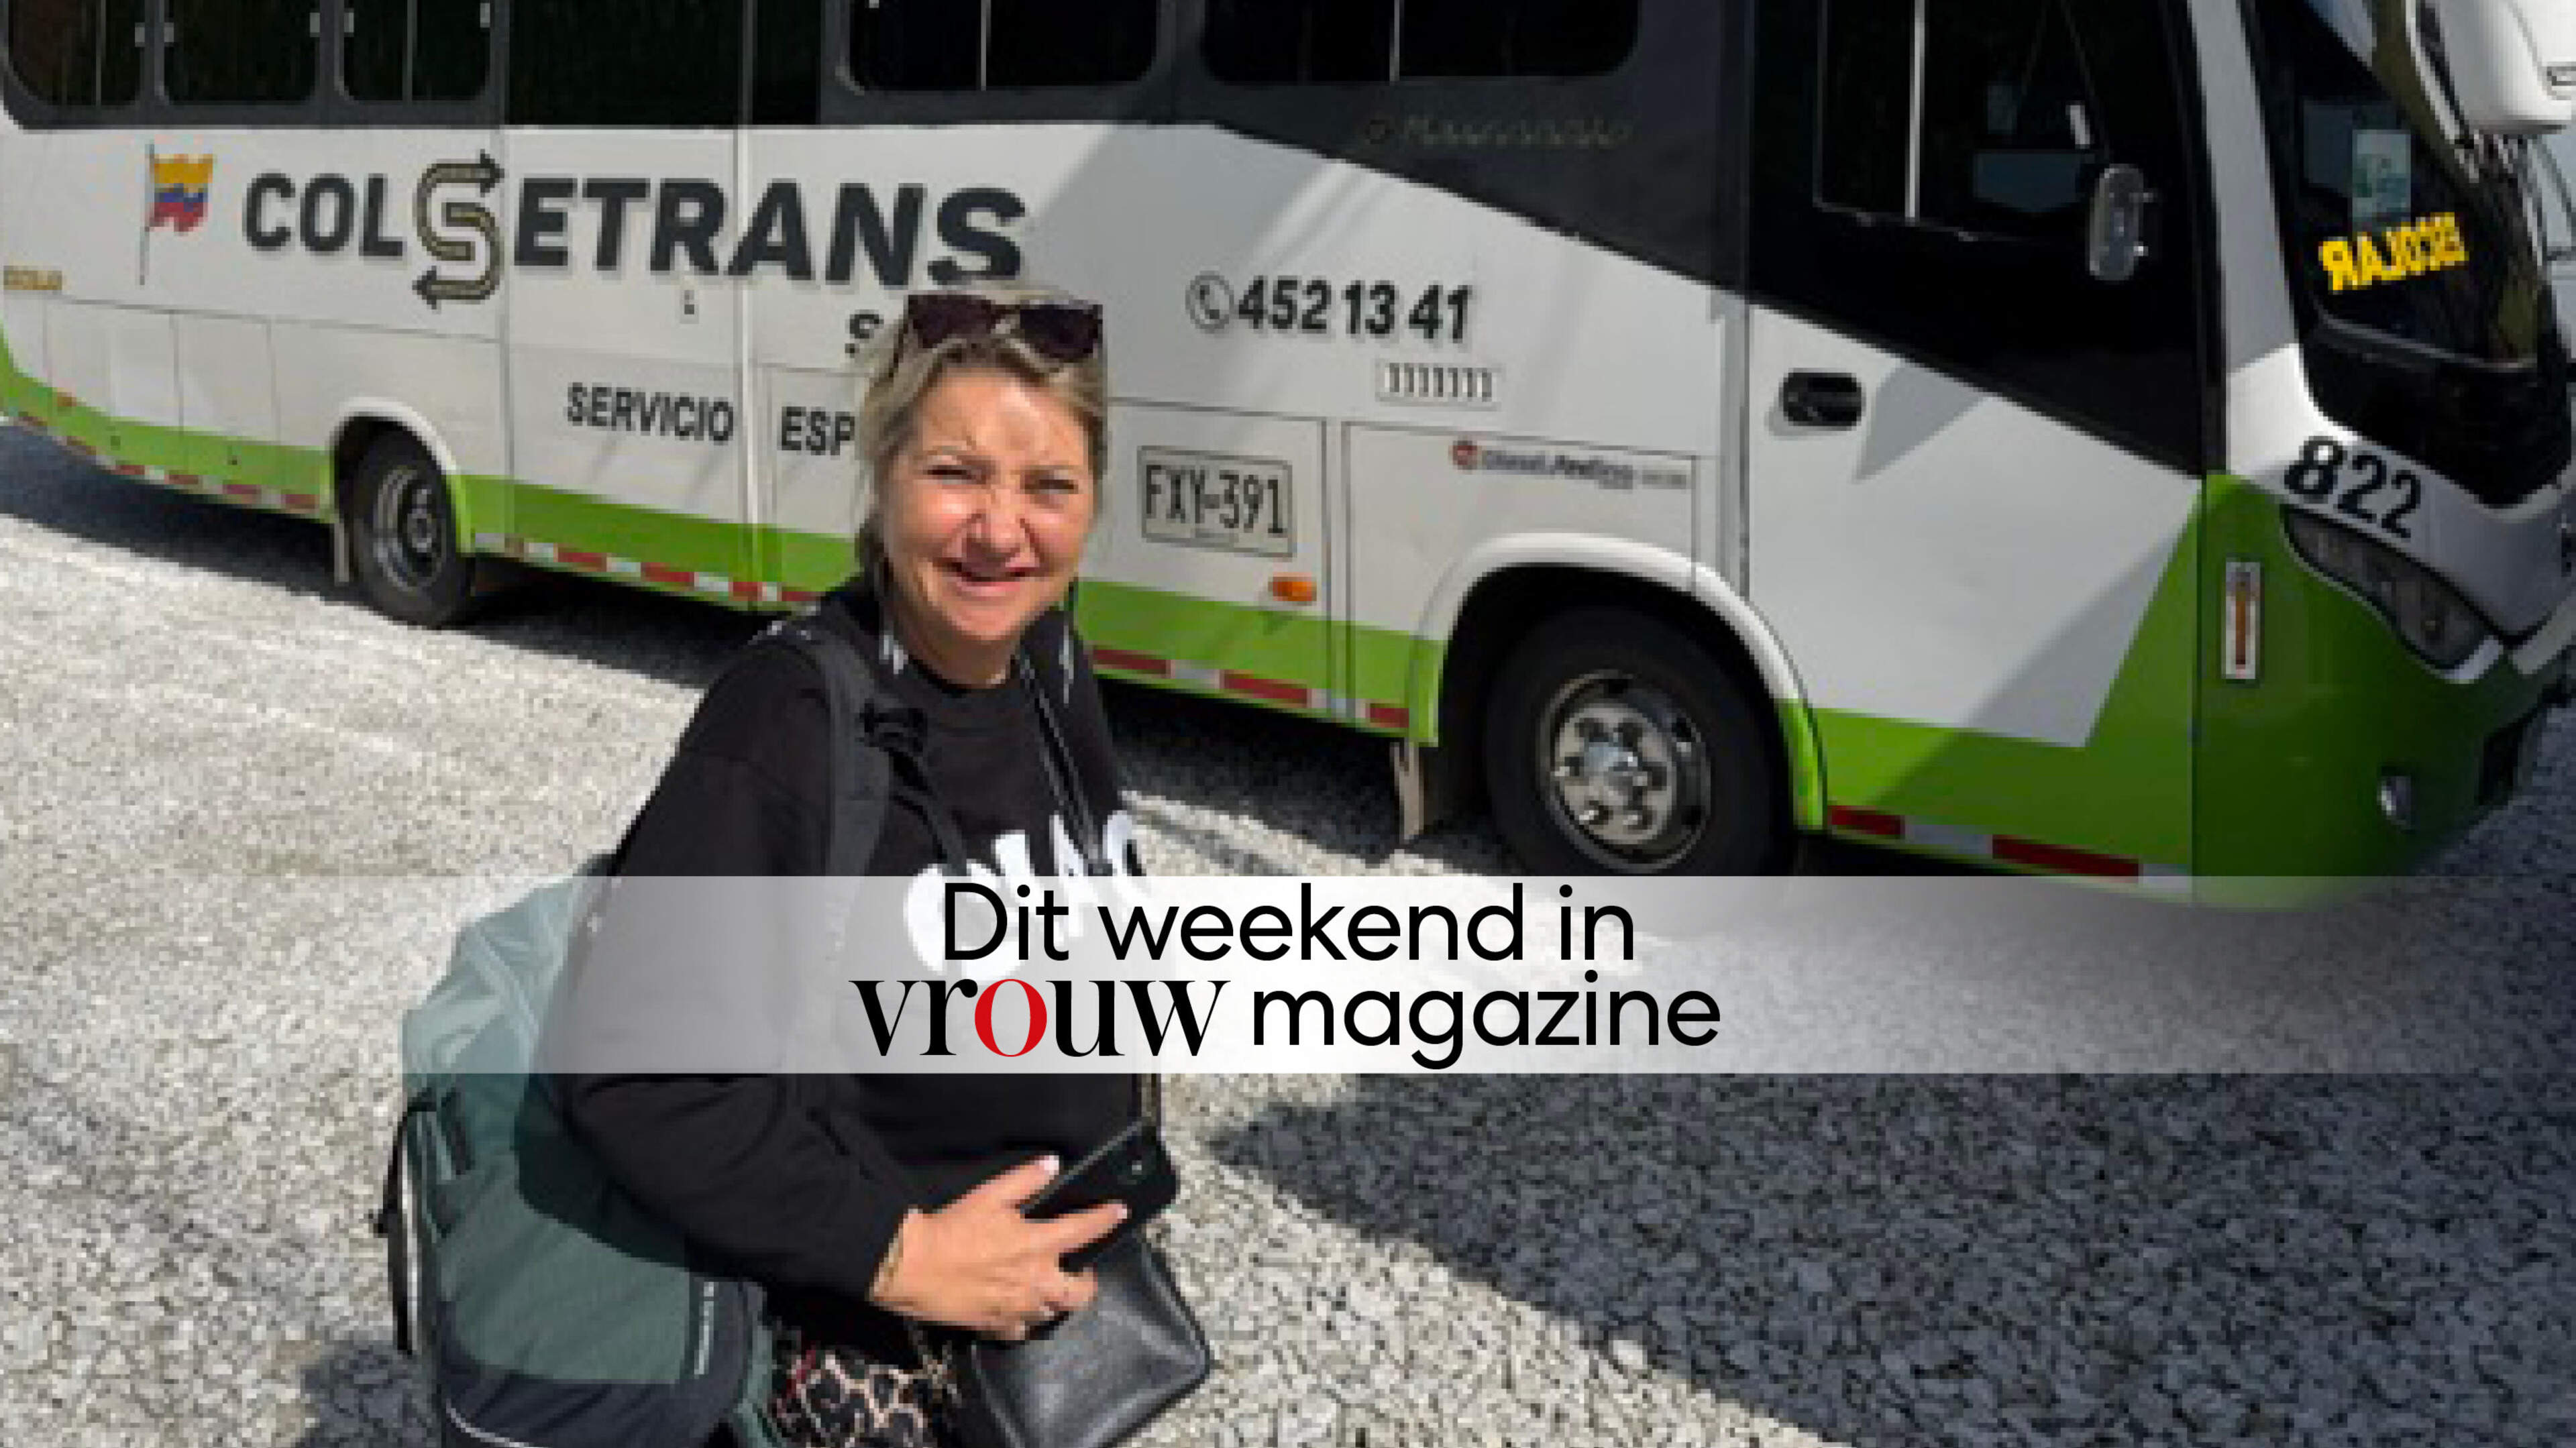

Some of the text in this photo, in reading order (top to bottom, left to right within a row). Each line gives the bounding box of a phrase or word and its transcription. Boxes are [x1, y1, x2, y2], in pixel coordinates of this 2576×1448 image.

[1236, 275, 1473, 343] 452 13 41
[567, 382, 734, 445] SERVICIO
[2284, 436, 2421, 539] 822
